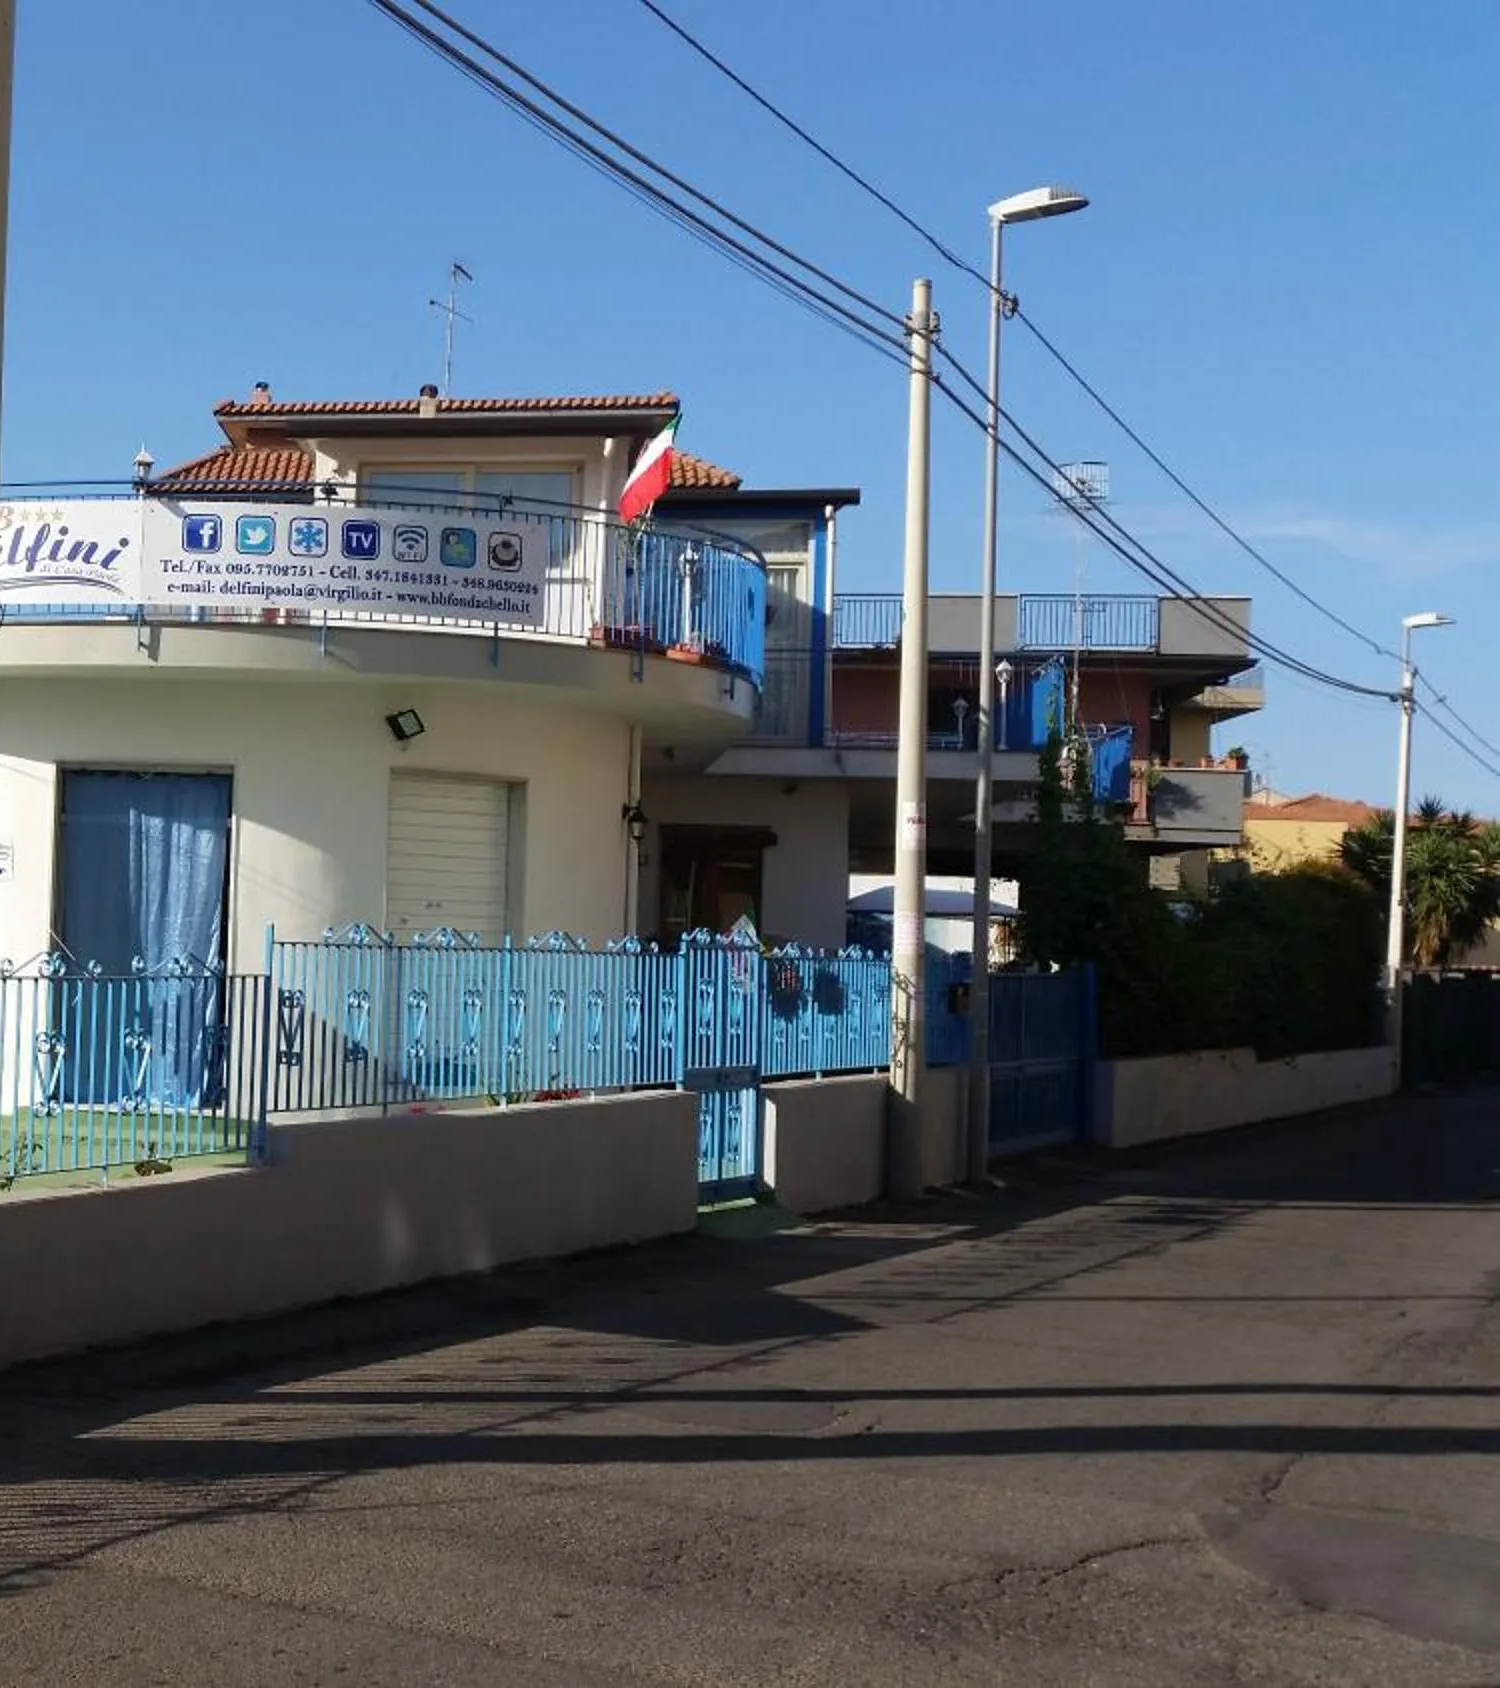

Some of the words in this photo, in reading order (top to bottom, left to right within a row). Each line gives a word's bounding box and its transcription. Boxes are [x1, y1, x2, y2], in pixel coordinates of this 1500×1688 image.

[349, 532, 373, 548] TV
[330, 565, 360, 580] Cell.
[167, 580, 215, 593] e-mail:
[220, 580, 382, 603] delfinipaola@virgilio.it
